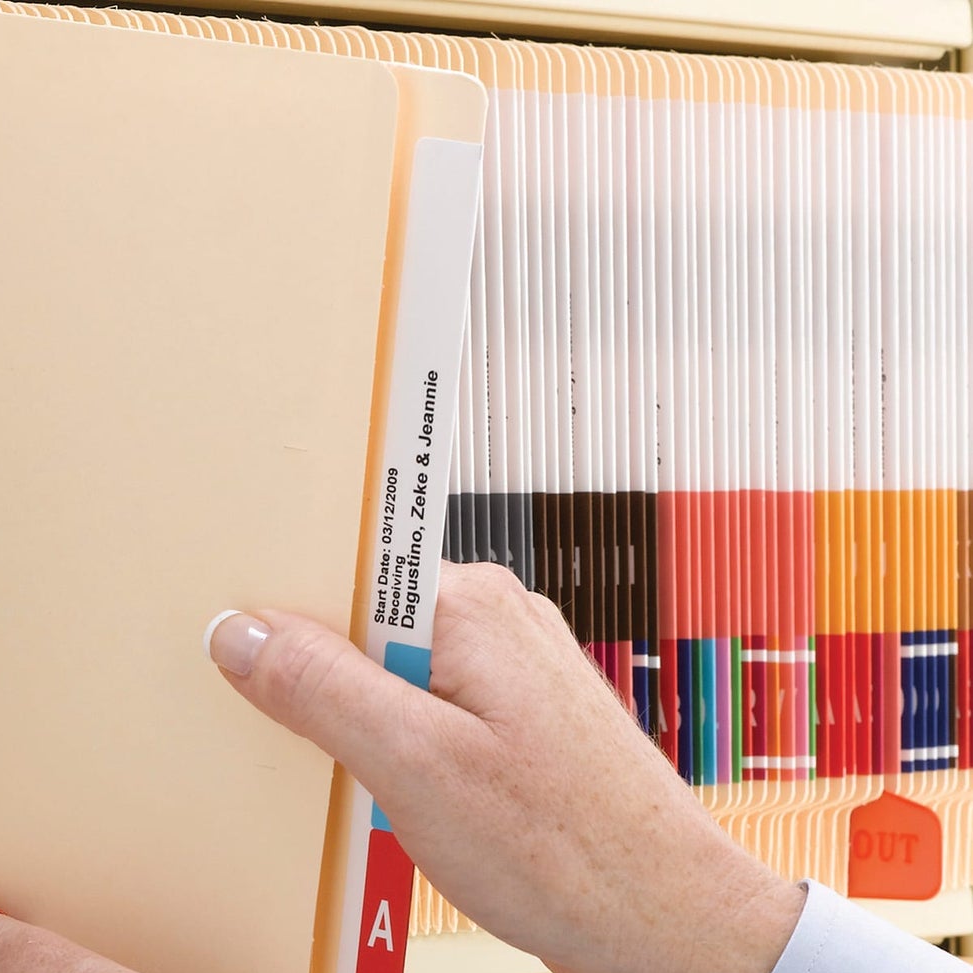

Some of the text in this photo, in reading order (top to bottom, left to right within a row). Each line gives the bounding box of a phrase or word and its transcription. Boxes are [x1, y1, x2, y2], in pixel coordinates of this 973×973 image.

[400, 369, 439, 630] Dagustino, Zeke & Jeannie
[373, 467, 399, 624] Start Date: 03/12/2009
[387, 555, 407, 627] Receiving
[853, 829, 920, 865] OUT
[366, 899, 395, 954] A
